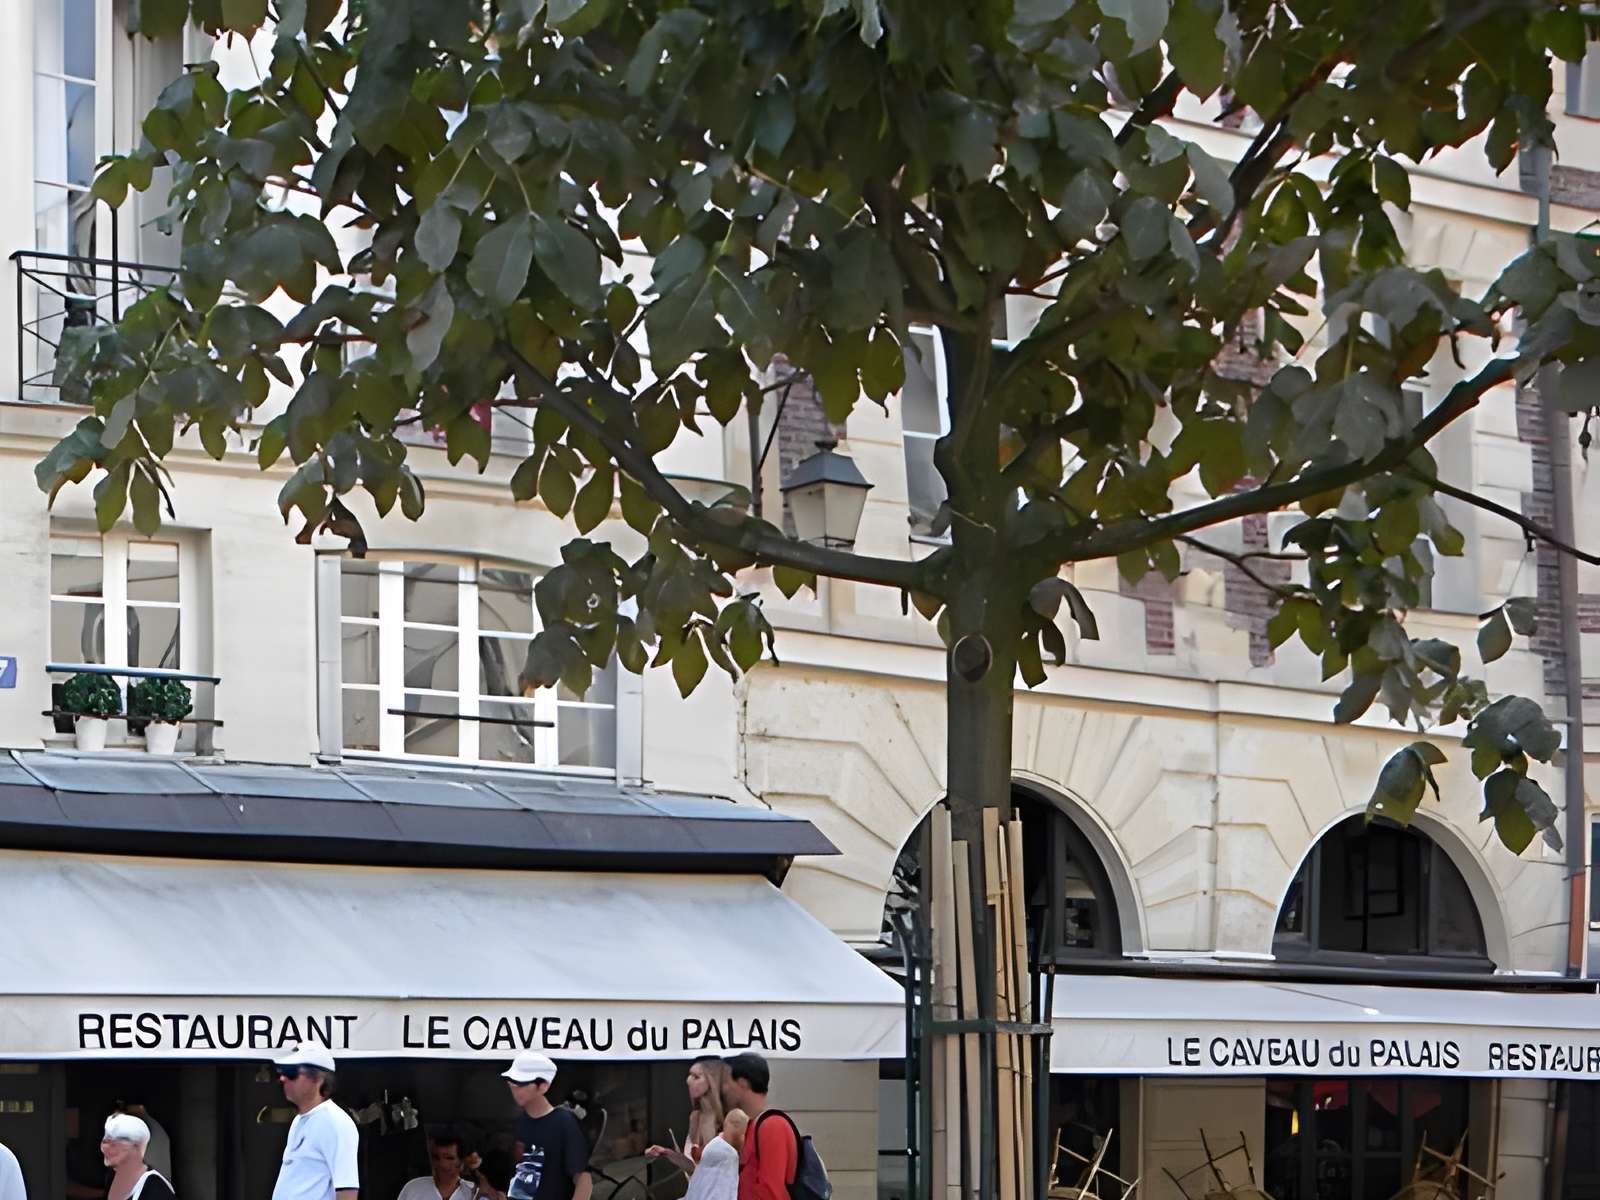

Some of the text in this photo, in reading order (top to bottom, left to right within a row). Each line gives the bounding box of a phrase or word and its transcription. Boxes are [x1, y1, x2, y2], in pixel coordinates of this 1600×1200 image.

[78, 1012, 801, 1051] RESTAURANT LE CAVEAU du PALAIS
[1167, 1037, 1201, 1067] LE
[1209, 1037, 1320, 1068] CAVEAU
[1329, 1040, 1360, 1068] du
[1370, 1039, 1460, 1069] PALAIS
